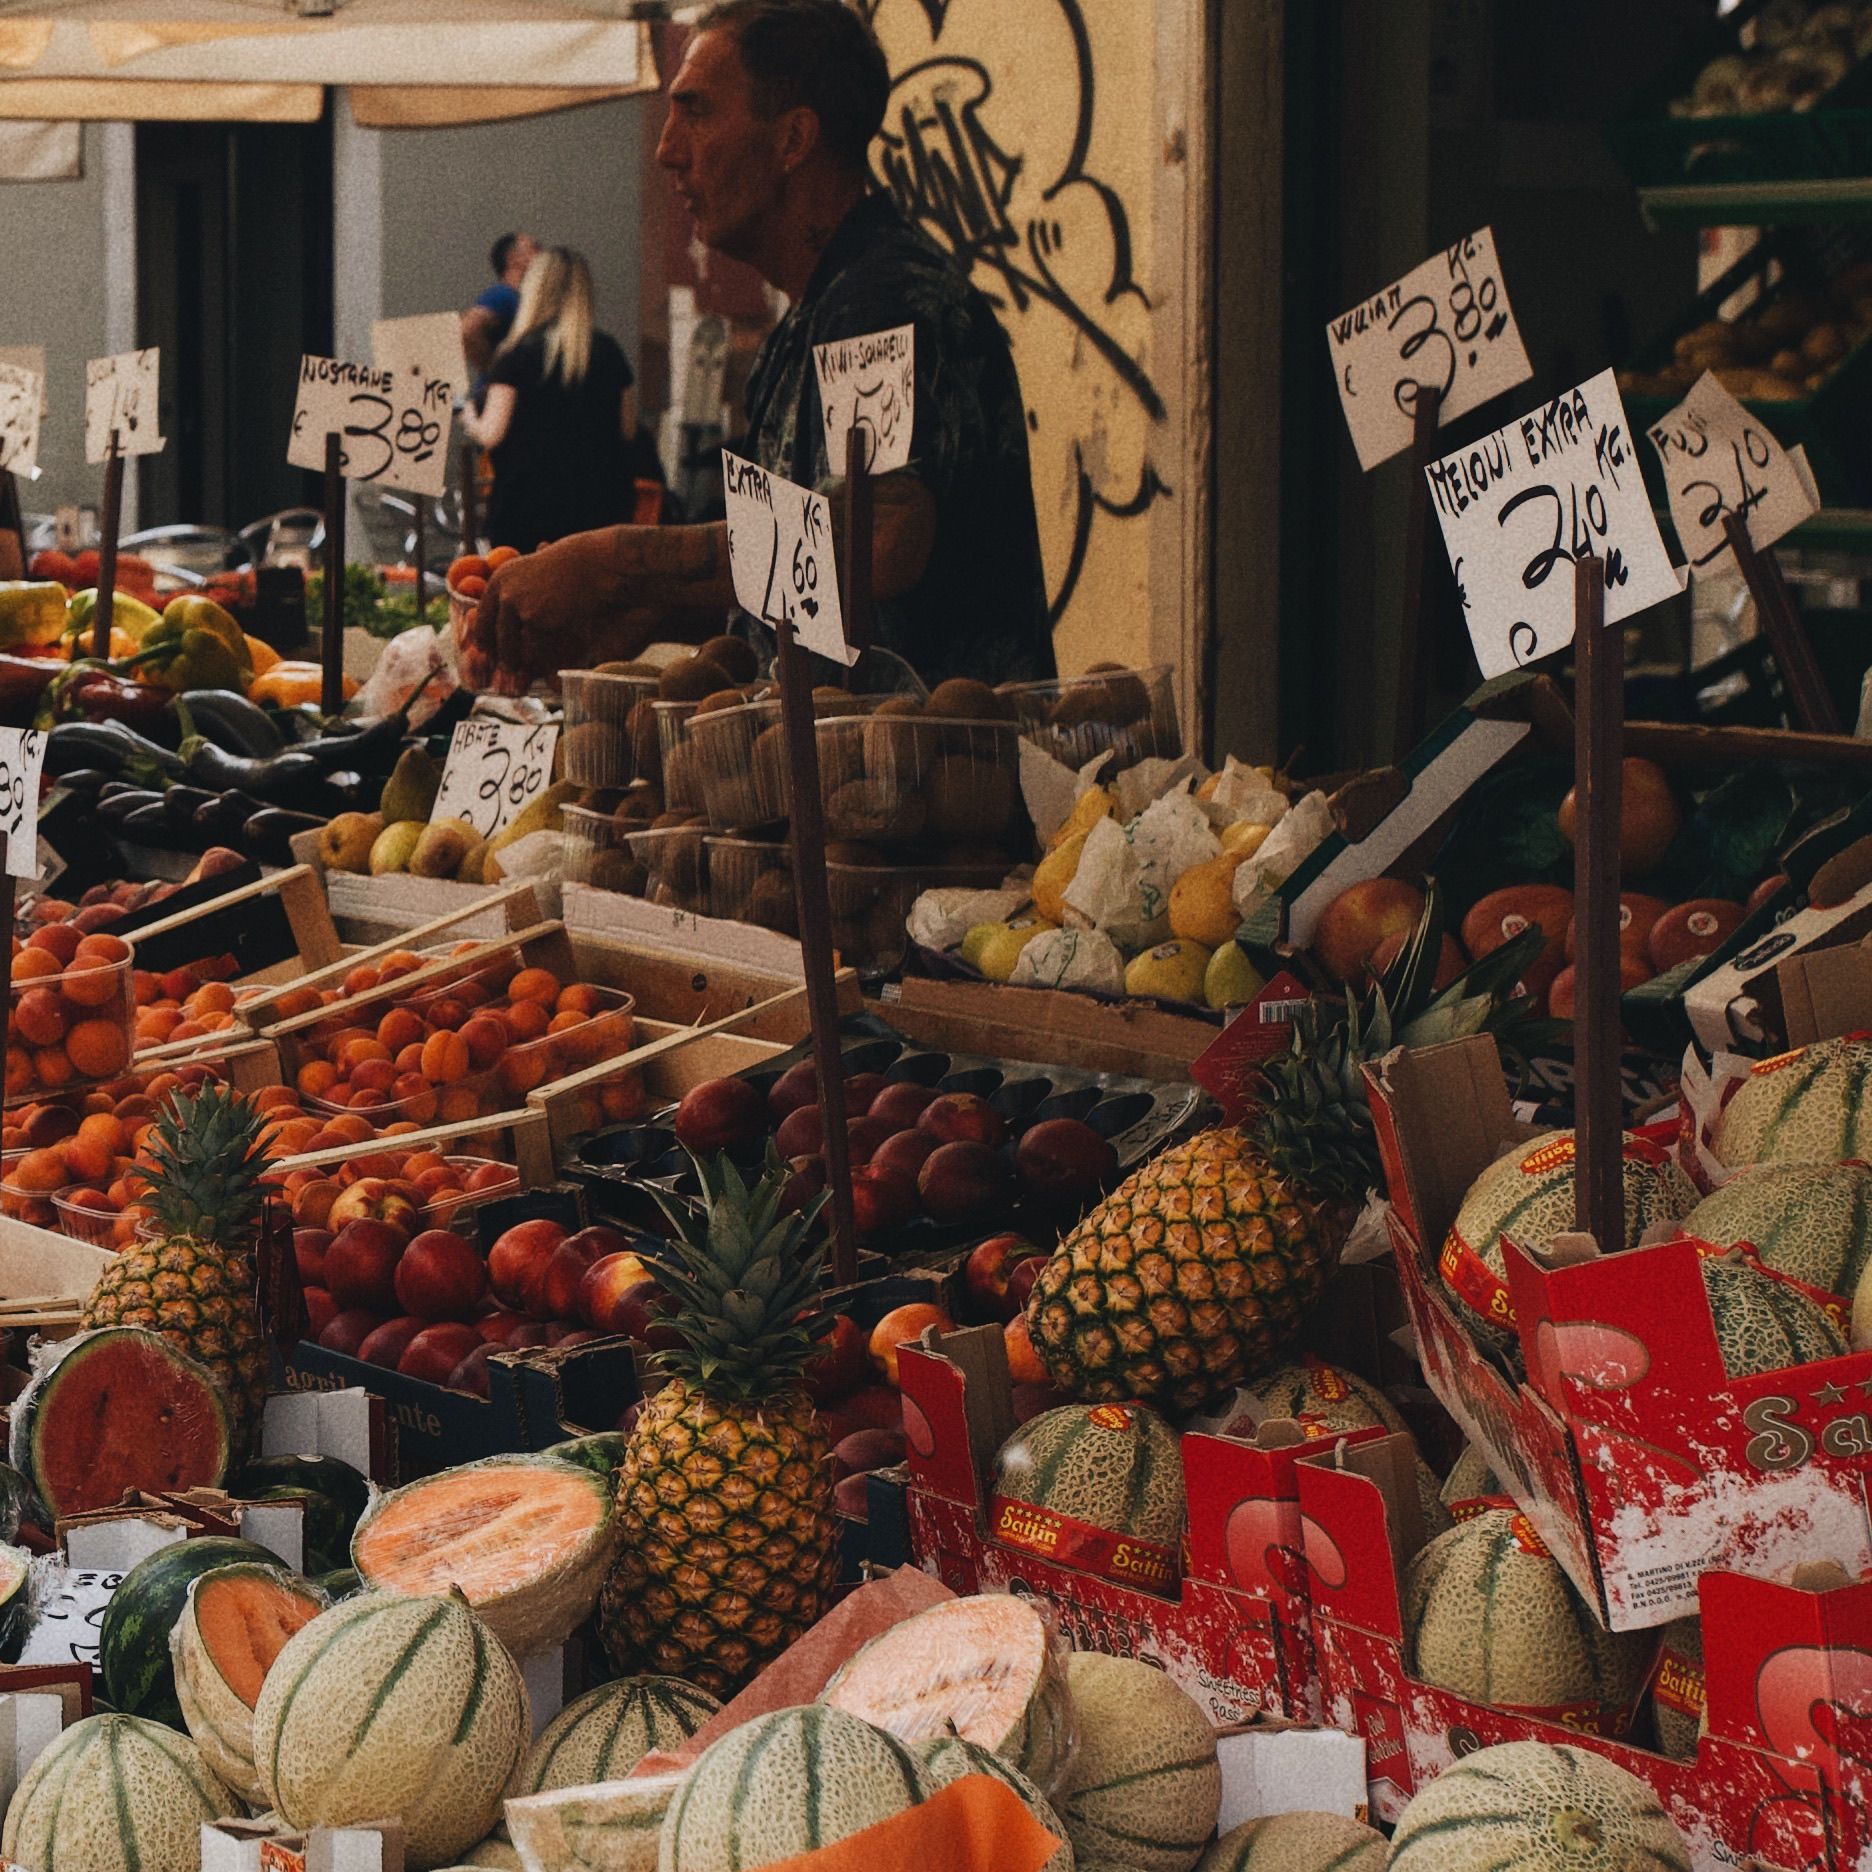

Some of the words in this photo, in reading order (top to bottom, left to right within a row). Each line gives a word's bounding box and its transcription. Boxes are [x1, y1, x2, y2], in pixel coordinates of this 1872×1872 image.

[1522, 388, 1594, 469] EXTRA
[725, 452, 772, 511] EXTRA
[1000, 1506, 1057, 1545] Sattin
[1113, 1544, 1174, 1578] Sattin
[1637, 1565, 1672, 1578] MARTINO
[1631, 1592, 1645, 1600] Fax
[1198, 1669, 1260, 1706] Sweetness
